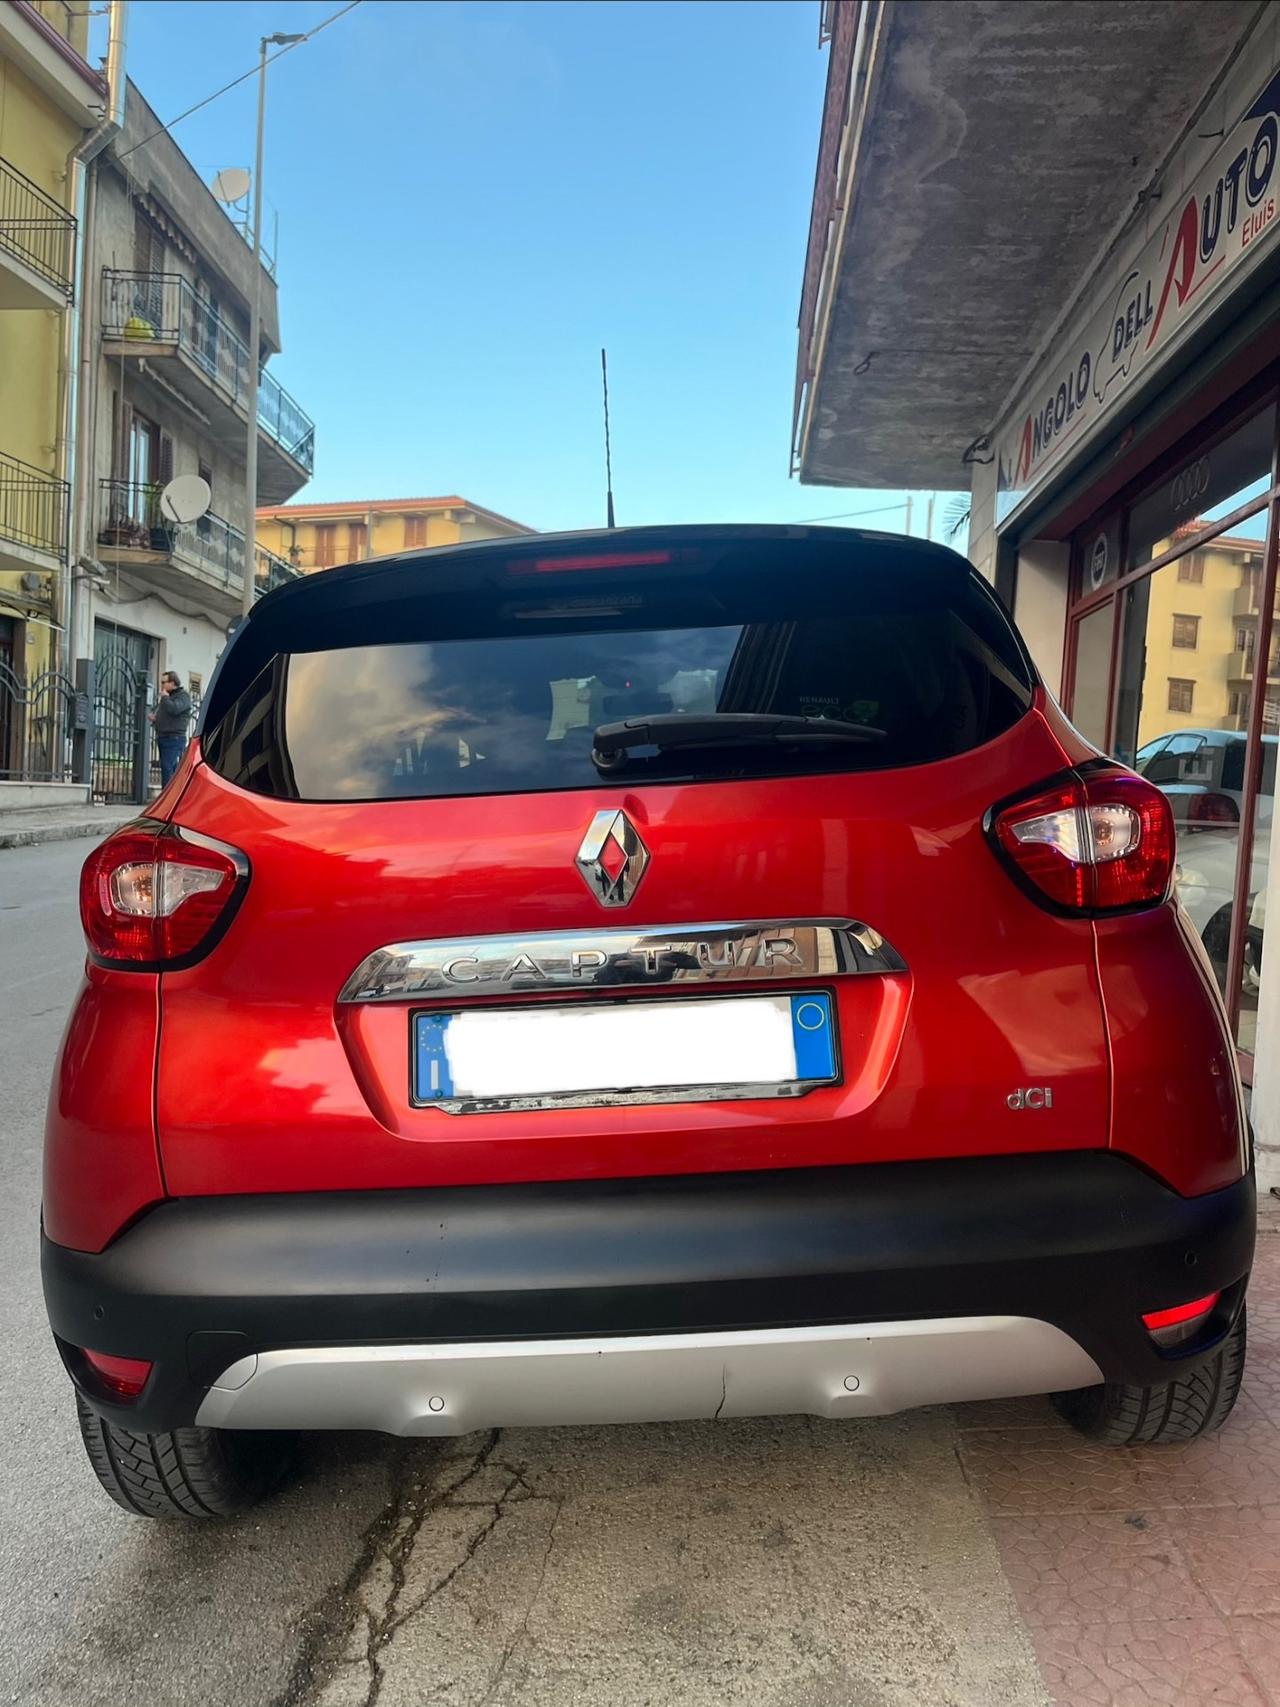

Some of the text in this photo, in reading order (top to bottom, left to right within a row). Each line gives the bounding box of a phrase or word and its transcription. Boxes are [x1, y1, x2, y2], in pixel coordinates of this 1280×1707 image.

[1241, 198, 1275, 248] Eluis
[441, 937, 804, 984] CAPTUR
[1007, 1087, 1052, 1110] dCi
